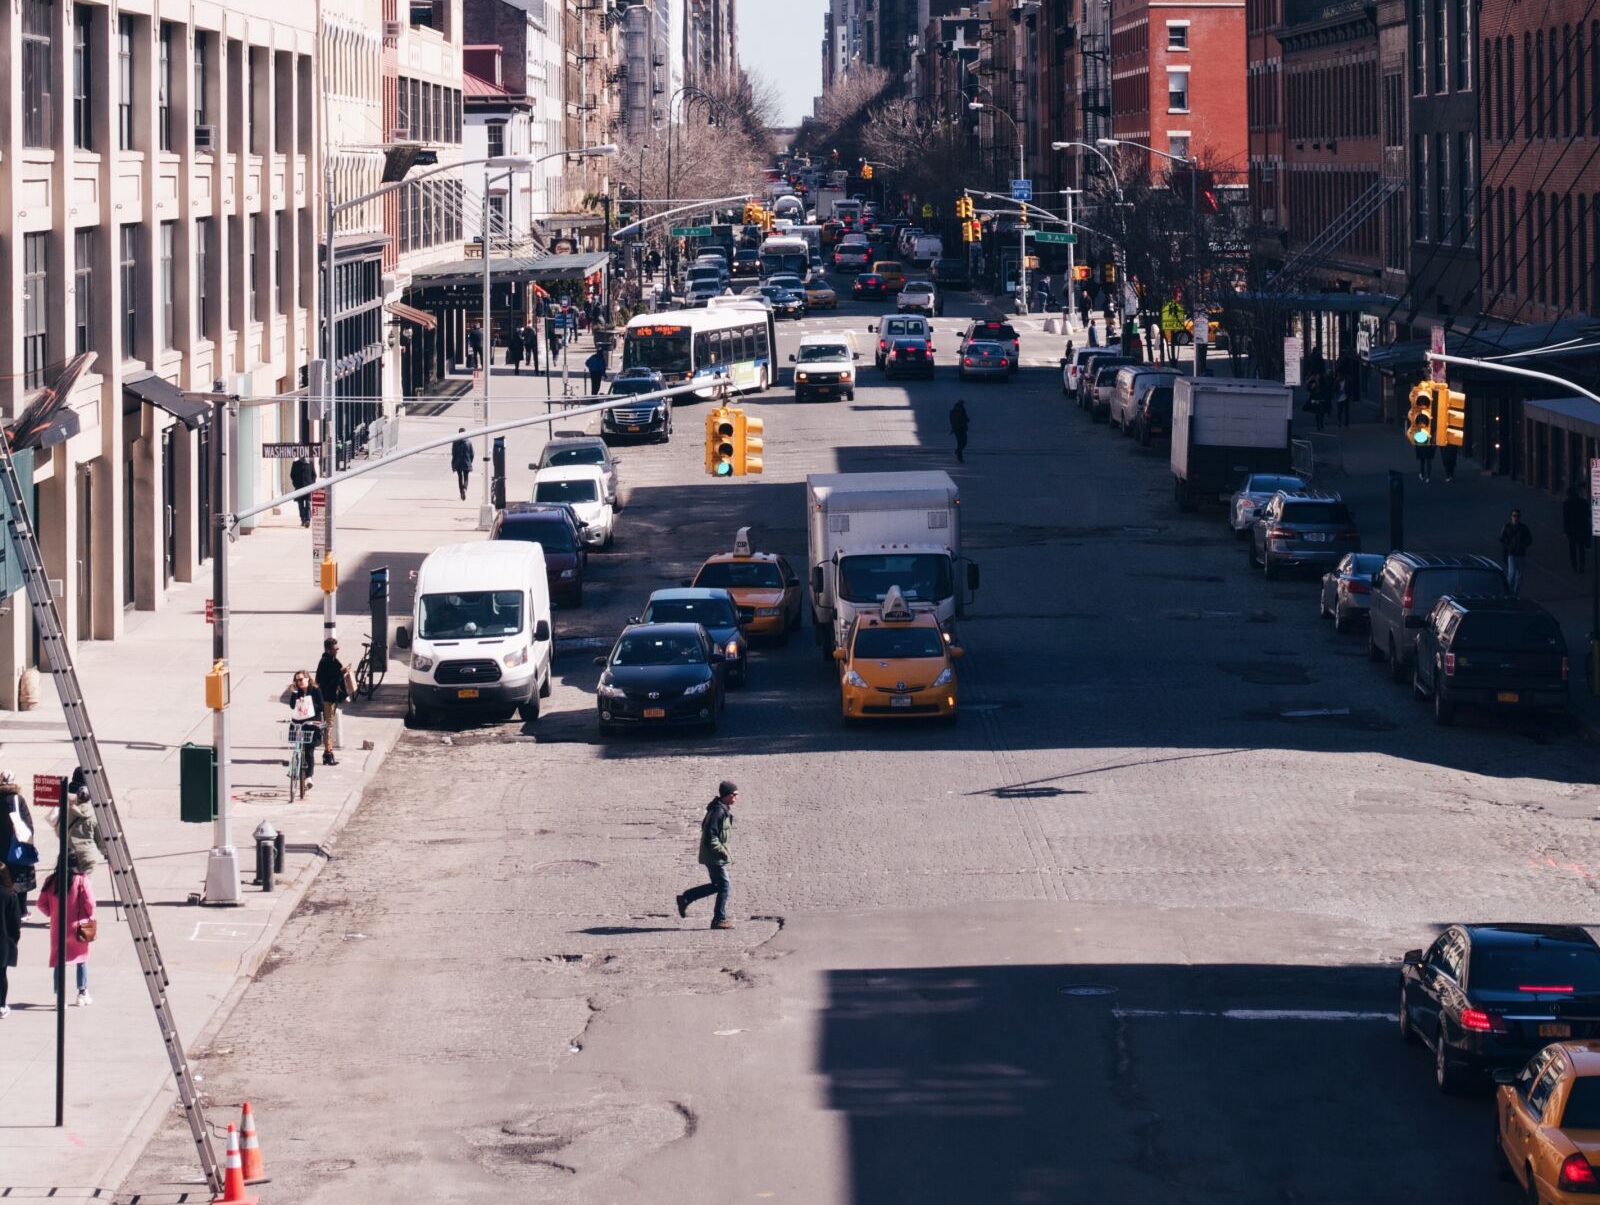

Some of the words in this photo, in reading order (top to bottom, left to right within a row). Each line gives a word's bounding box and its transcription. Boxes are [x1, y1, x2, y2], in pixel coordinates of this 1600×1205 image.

[264, 445, 310, 458] WASHINGTON
[312, 445, 322, 457] ST
[35, 785, 53, 793] Anytime
